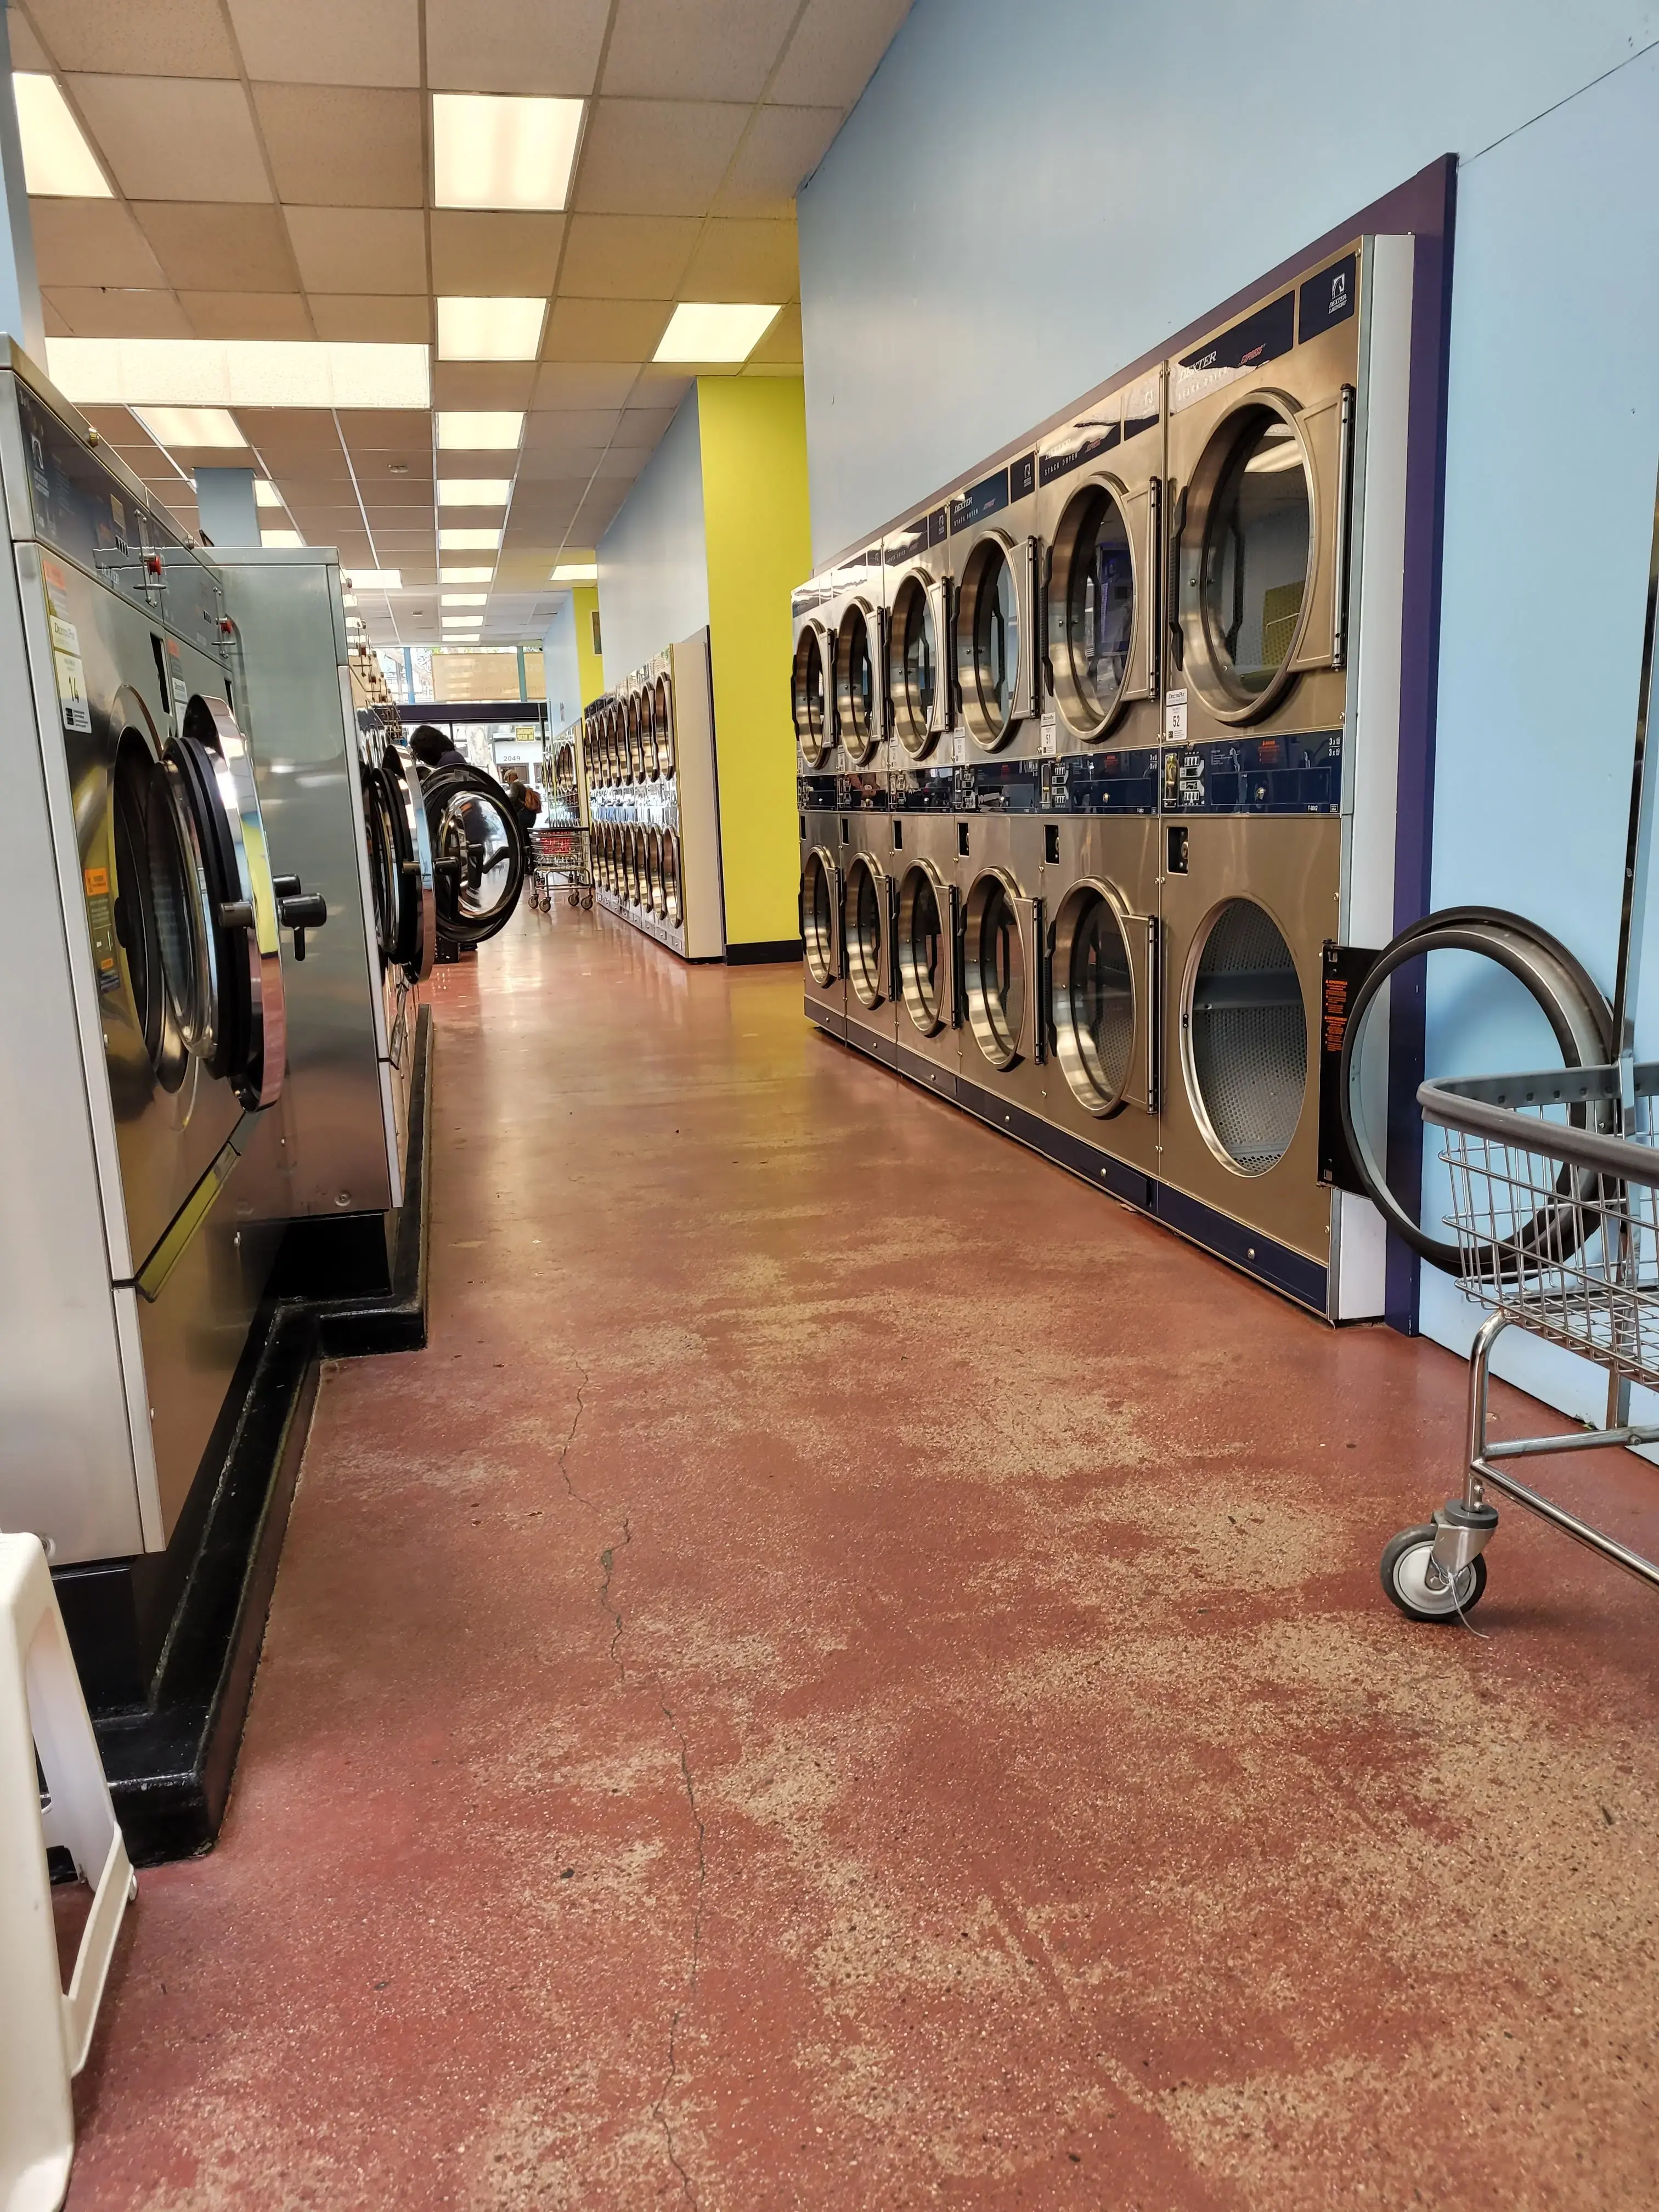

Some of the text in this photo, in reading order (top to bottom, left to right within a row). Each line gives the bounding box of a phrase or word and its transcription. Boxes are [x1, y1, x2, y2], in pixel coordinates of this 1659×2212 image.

[1328, 294, 1347, 309] DEXTER
[1178, 351, 1217, 382] DEXTER
[1178, 368, 1228, 401] STACK DRYER
[1045, 452, 1078, 476] STACK DRYER
[953, 496, 973, 514] DEXTER
[69, 676, 80, 703] 14
[1173, 715, 1180, 727] 52
[1046, 733, 1051, 744] 51
[1329, 737, 1333, 746] 3
[1329, 748, 1332, 757] 3
